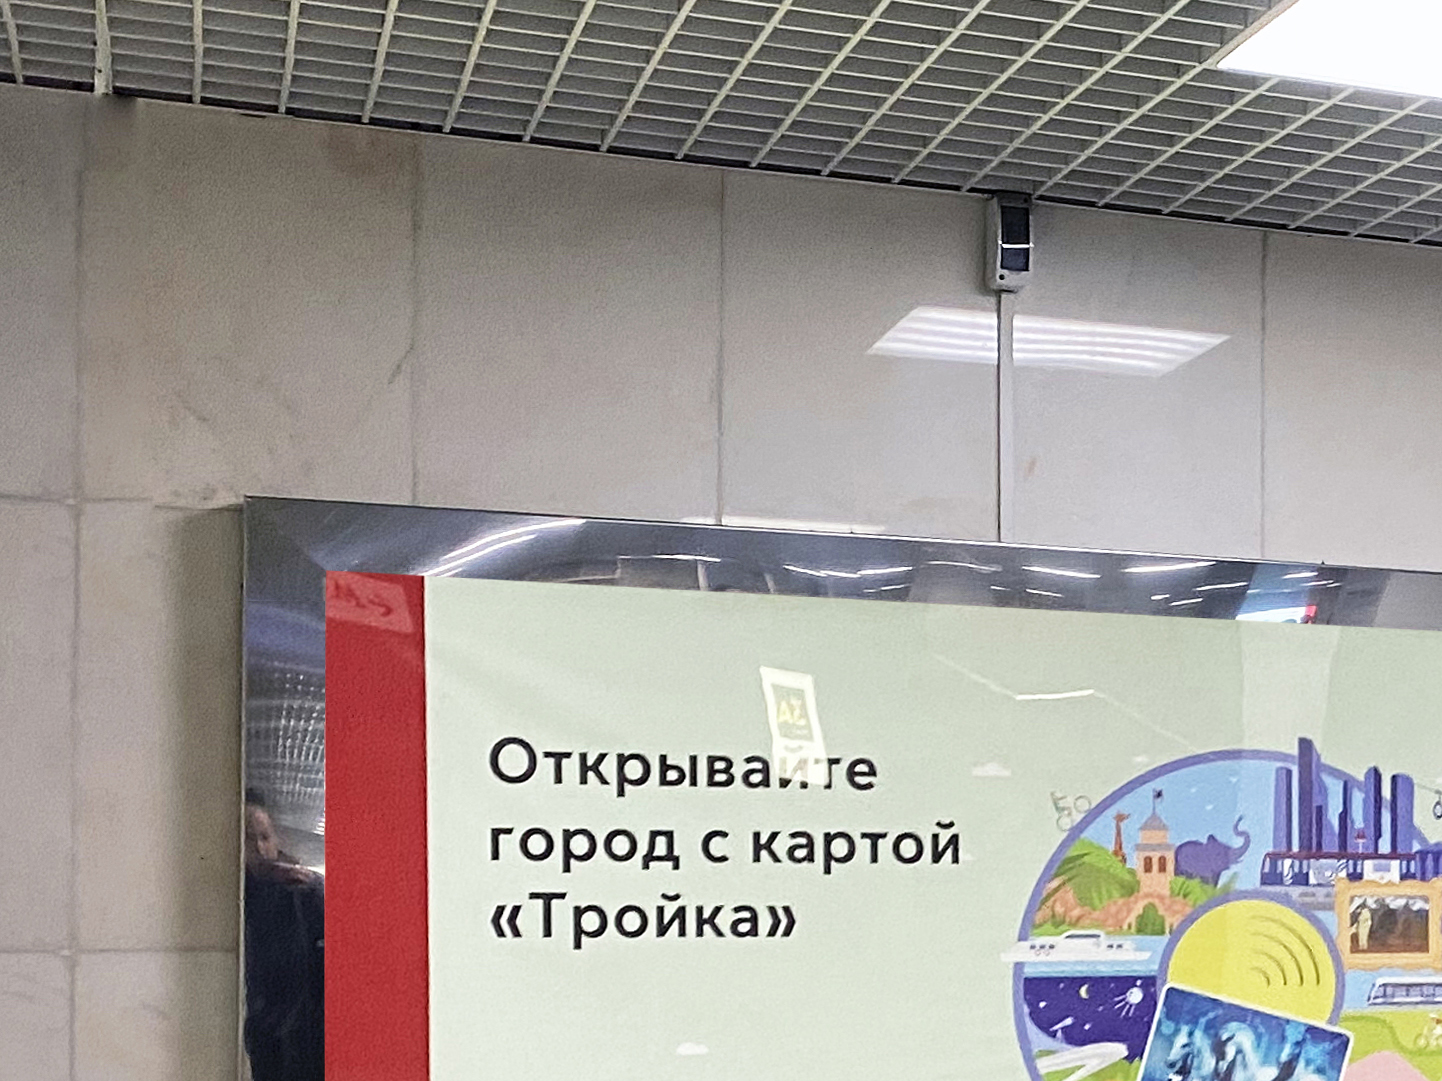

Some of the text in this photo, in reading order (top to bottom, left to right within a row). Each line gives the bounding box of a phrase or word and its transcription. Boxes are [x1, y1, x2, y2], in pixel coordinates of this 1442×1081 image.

[490, 820, 960, 875] город с картой
[491, 891, 796, 950] «Тройка»
